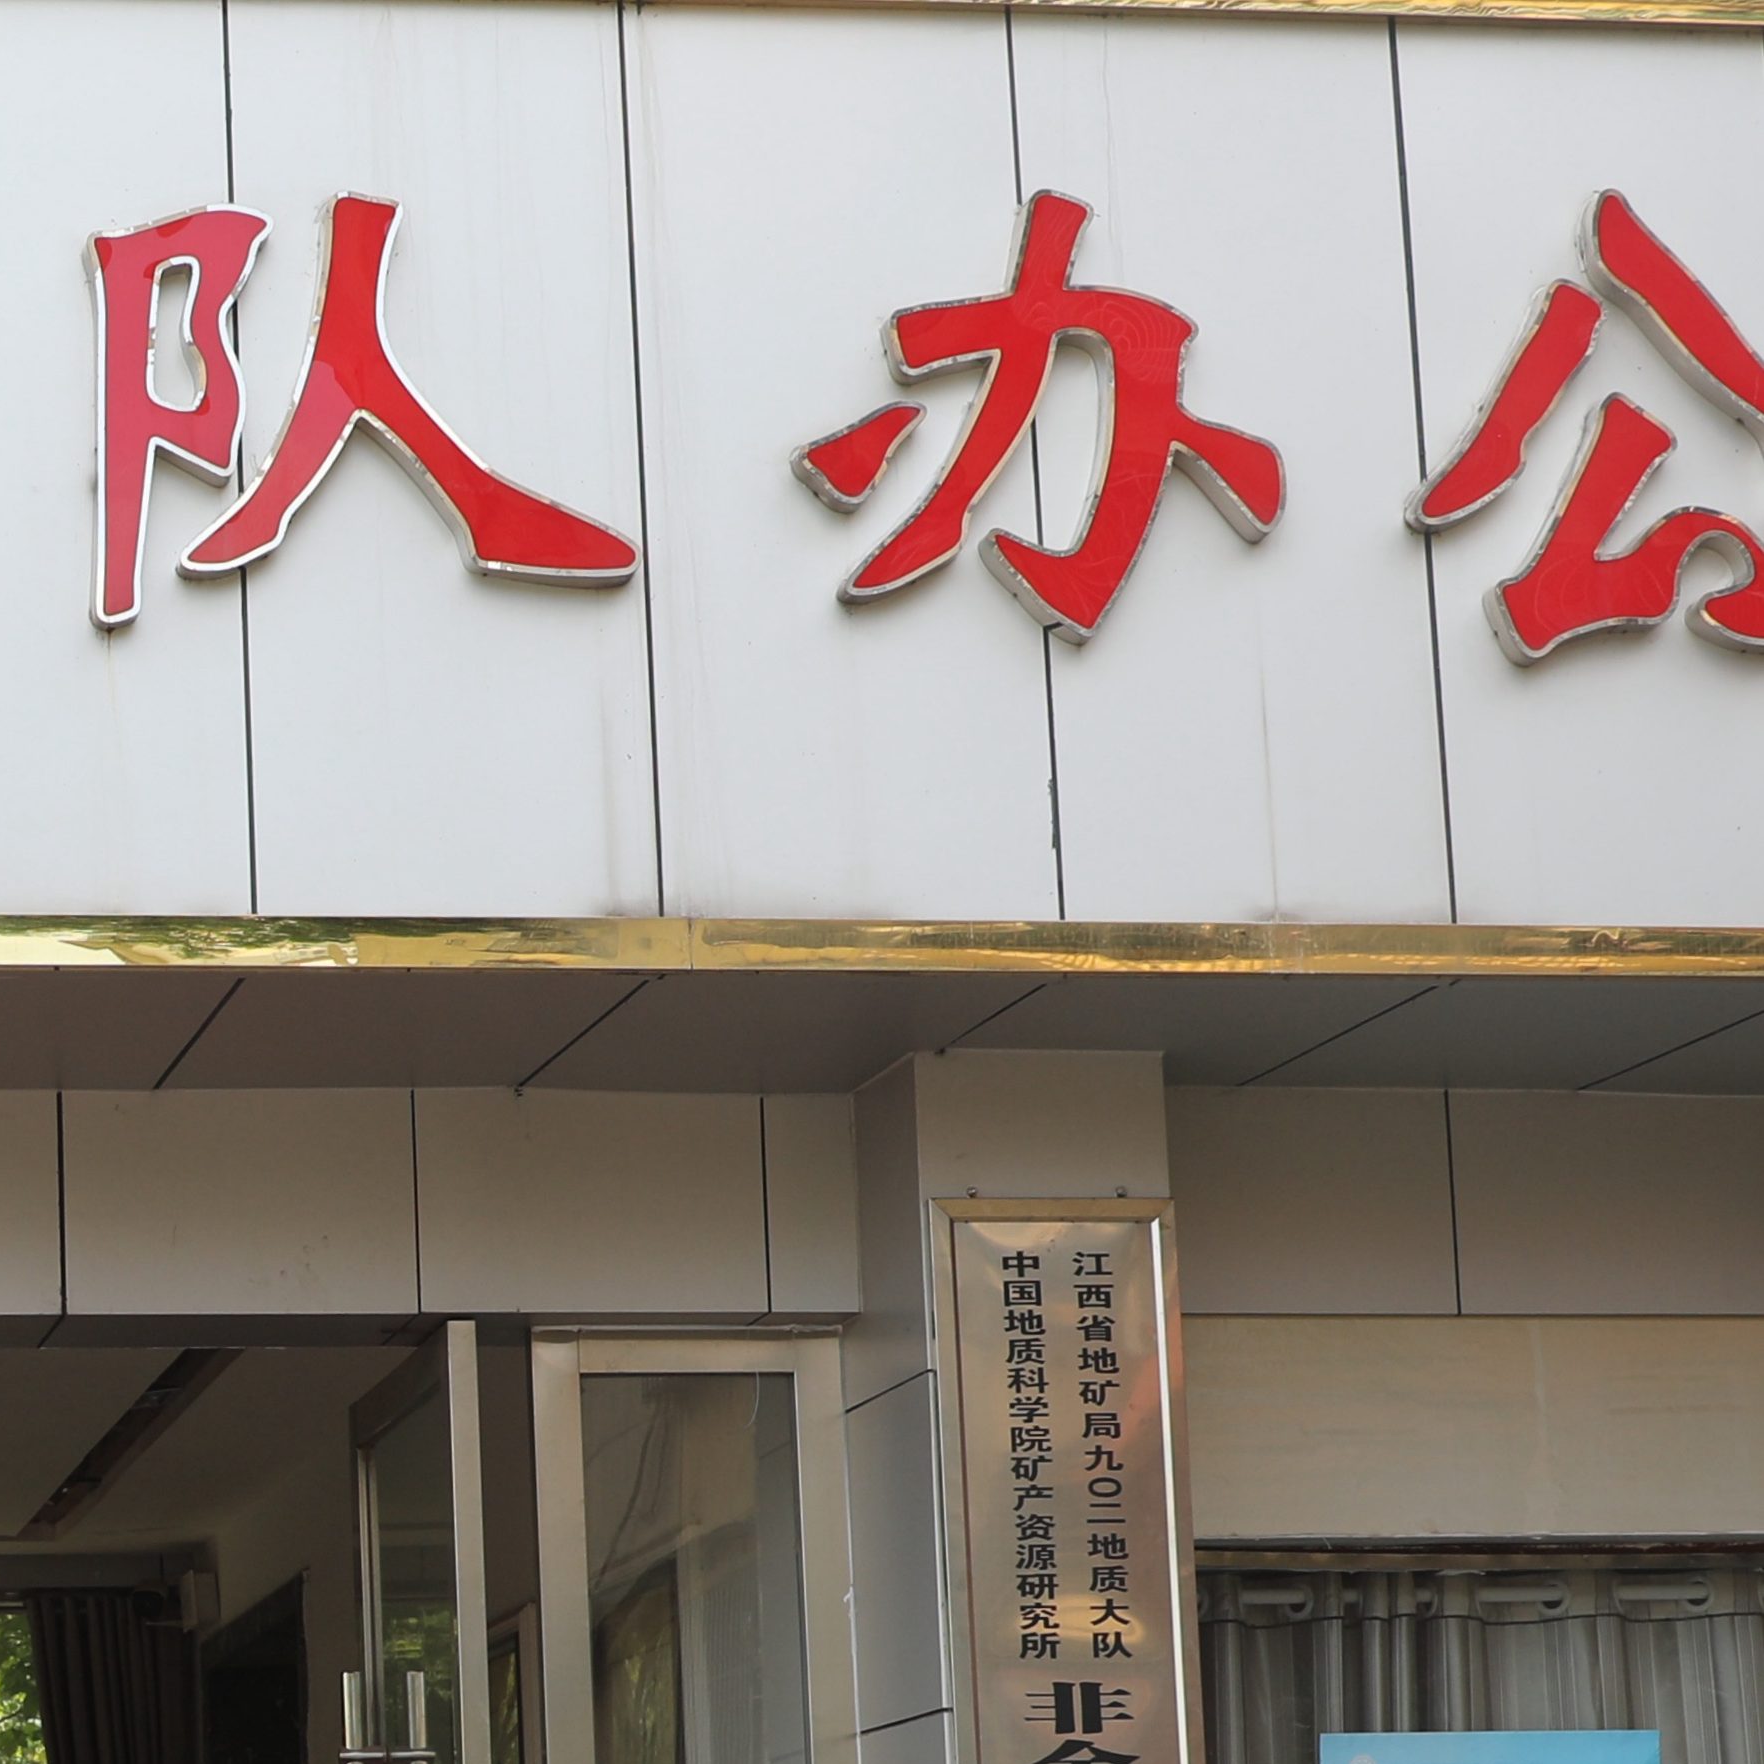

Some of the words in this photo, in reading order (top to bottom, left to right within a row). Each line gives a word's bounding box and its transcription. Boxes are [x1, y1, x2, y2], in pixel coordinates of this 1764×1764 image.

[1001, 1250, 1062, 1660] 中国地质科学院矿产资源研究所
